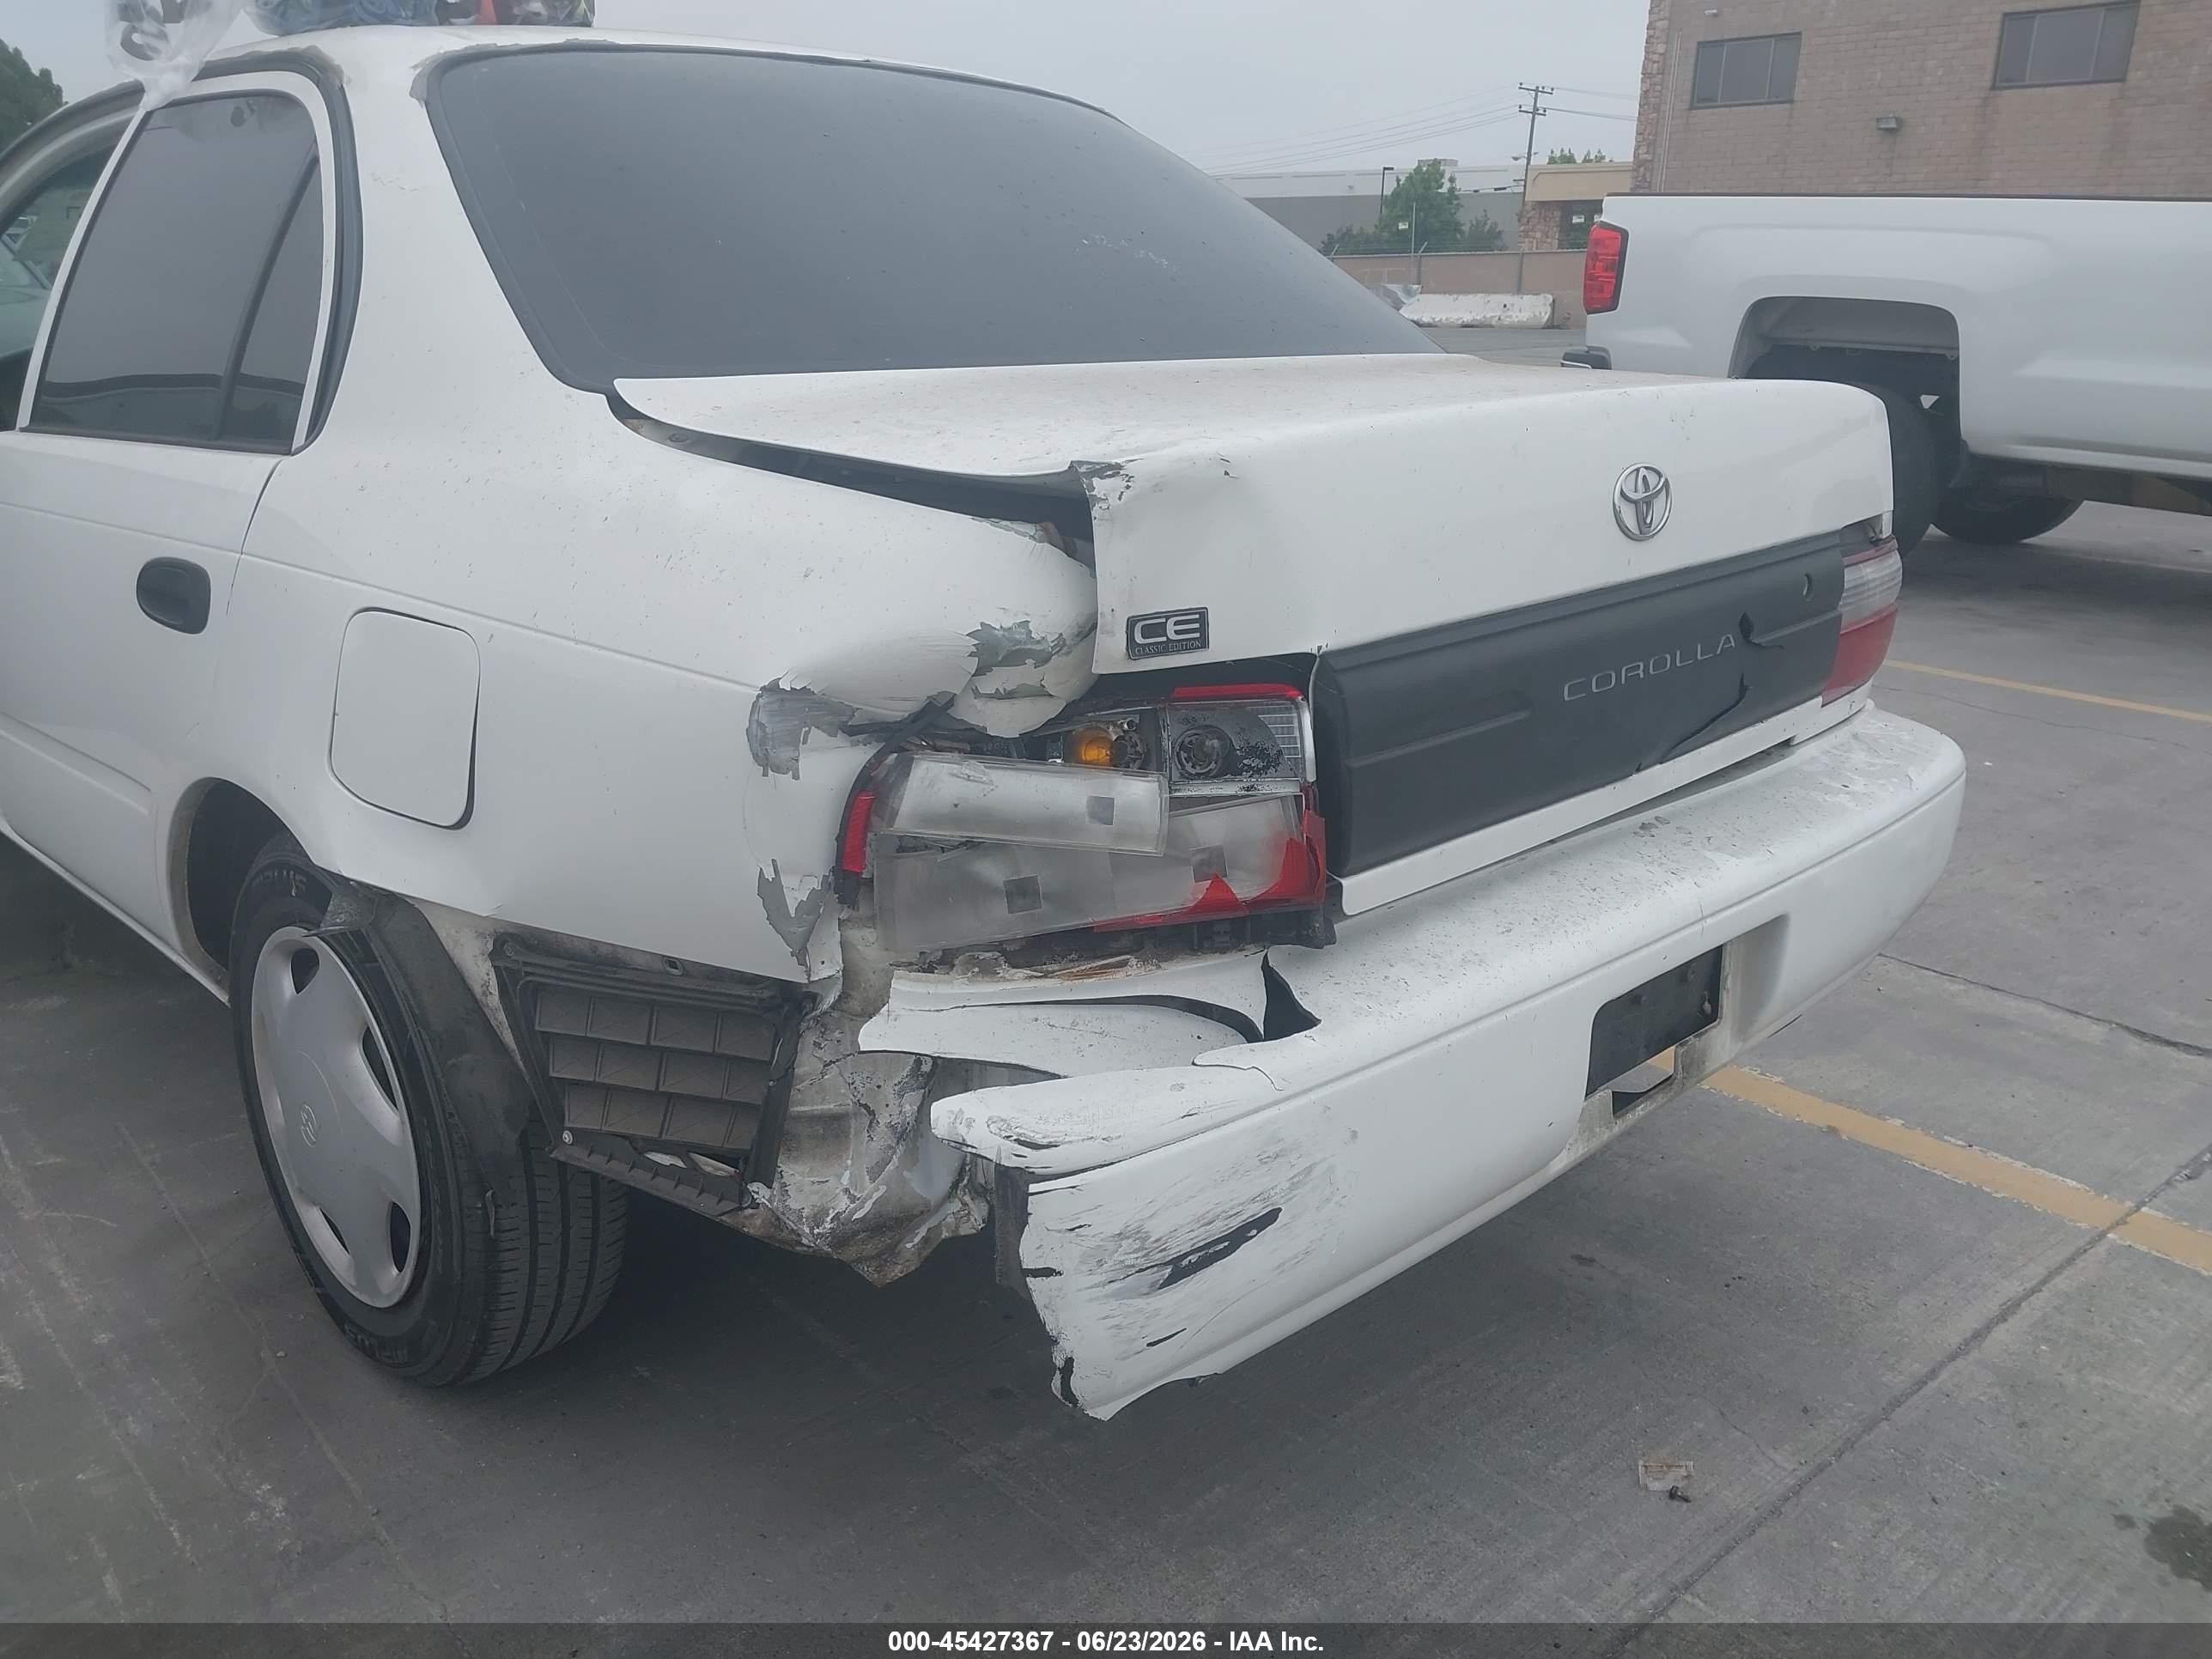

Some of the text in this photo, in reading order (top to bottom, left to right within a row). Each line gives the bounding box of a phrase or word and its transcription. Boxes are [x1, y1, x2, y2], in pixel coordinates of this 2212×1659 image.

[1133, 614, 1200, 644] CE
[1135, 640, 1201, 655] CLASSIC EDITION
[1564, 634, 1736, 702] COROLLA
